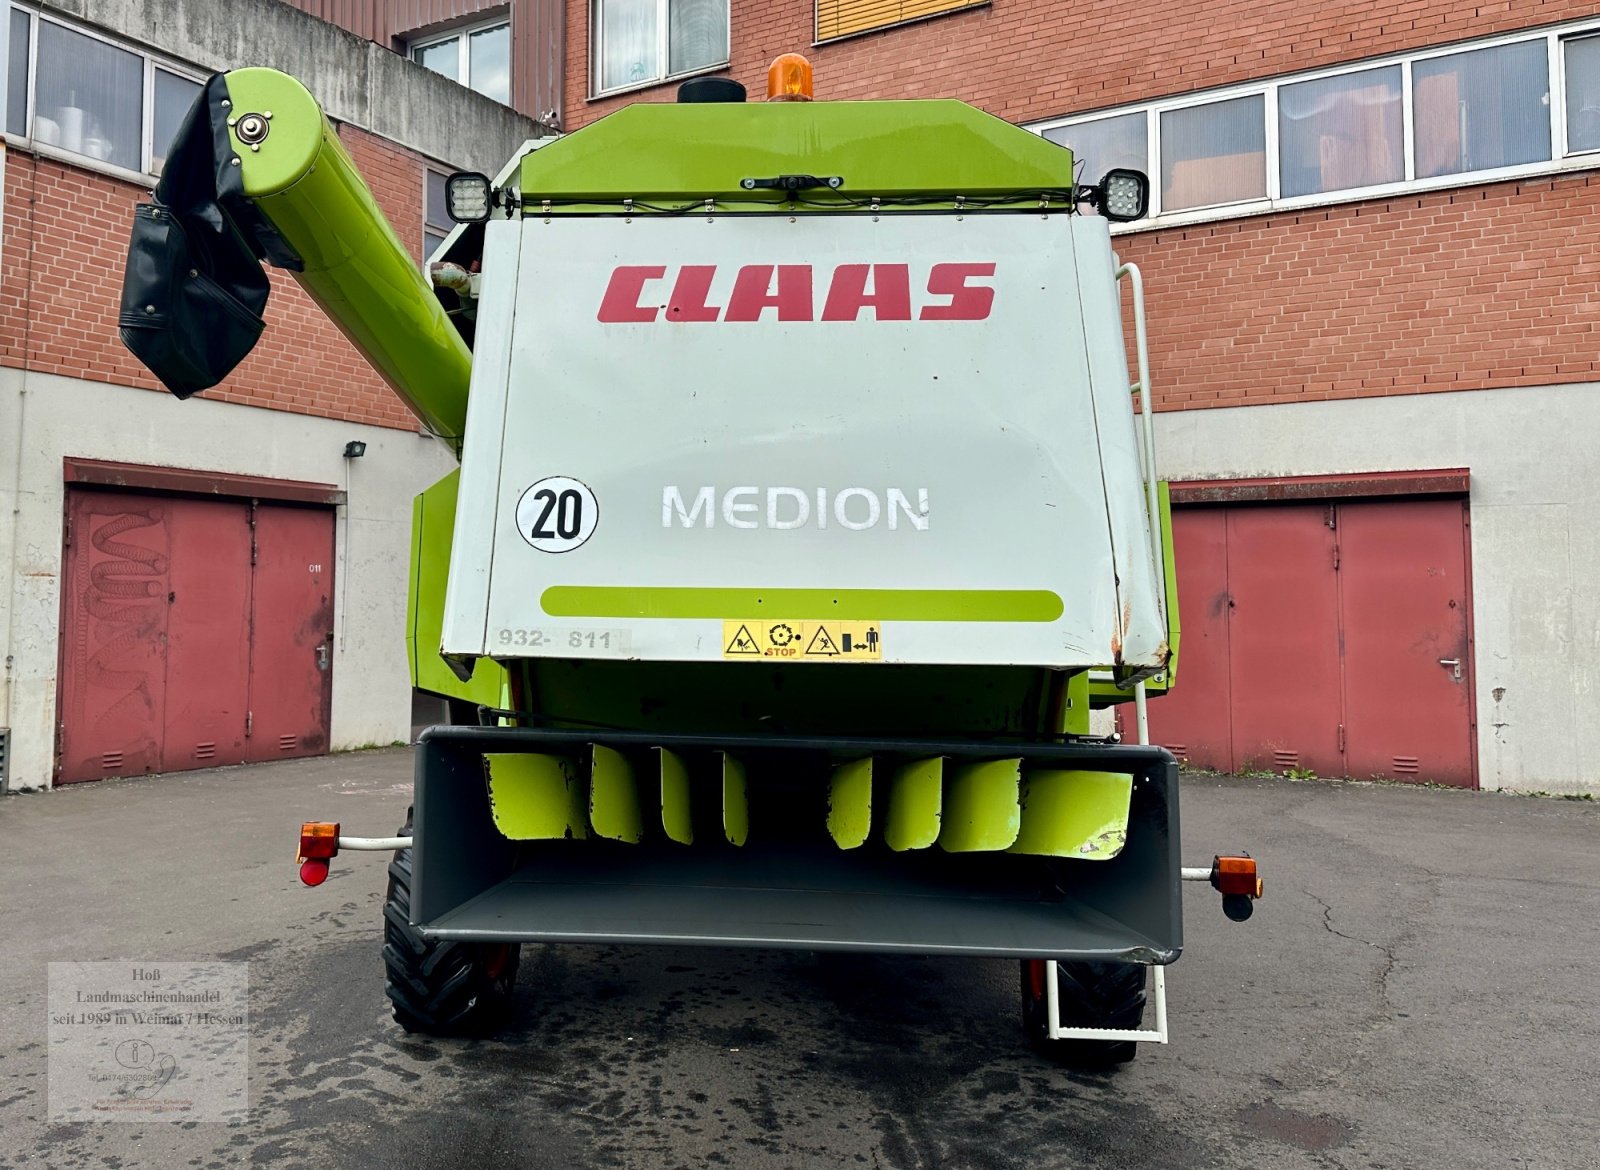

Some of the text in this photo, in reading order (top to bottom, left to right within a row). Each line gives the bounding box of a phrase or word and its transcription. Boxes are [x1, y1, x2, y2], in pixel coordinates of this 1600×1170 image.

[597, 262, 997, 323] CLAAS
[531, 488, 583, 540] 20
[661, 485, 930, 531] MEDION
[308, 564, 321, 573] 011
[568, 630, 611, 649] 811
[766, 647, 797, 657] STOP
